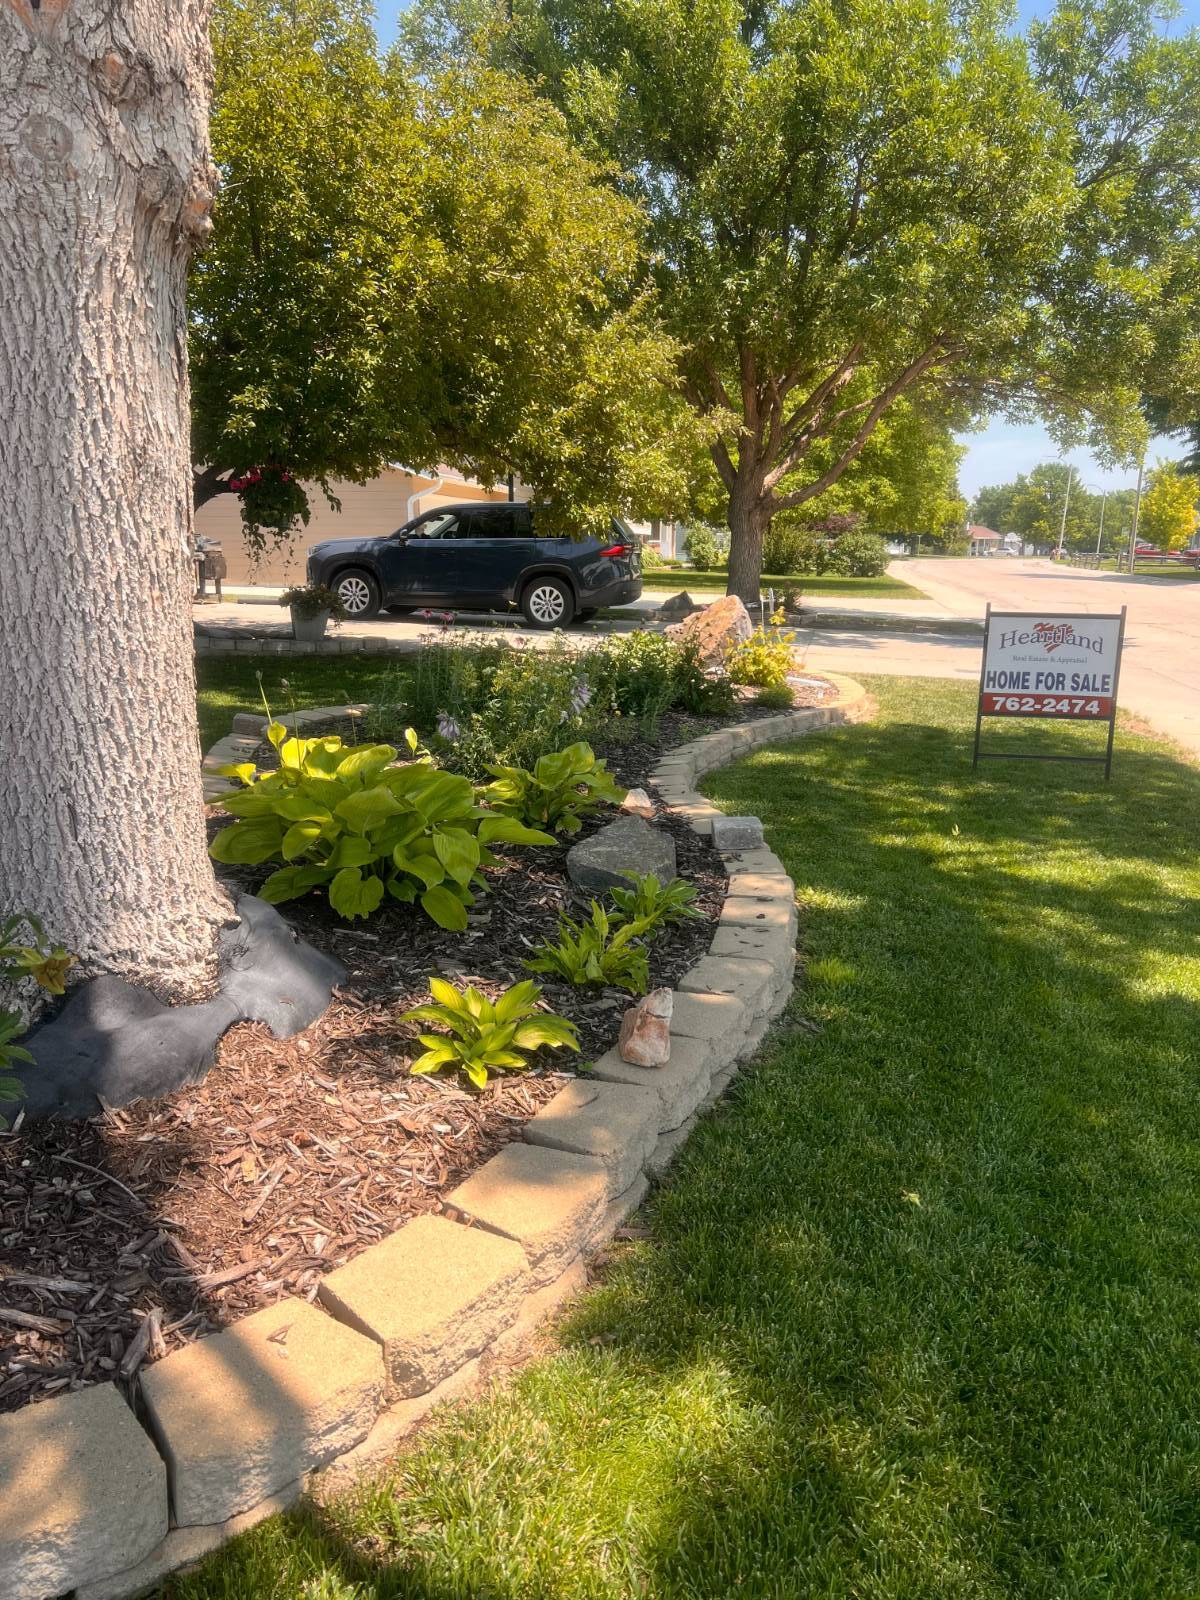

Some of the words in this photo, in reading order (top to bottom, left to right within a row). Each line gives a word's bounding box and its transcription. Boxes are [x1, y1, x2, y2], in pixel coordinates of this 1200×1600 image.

[999, 627, 1103, 654] Heartland
[986, 671, 1030, 689] HOME
[1035, 672, 1066, 691] FOR
[1070, 673, 1111, 692] SALE
[992, 697, 1100, 714] 762-2474
